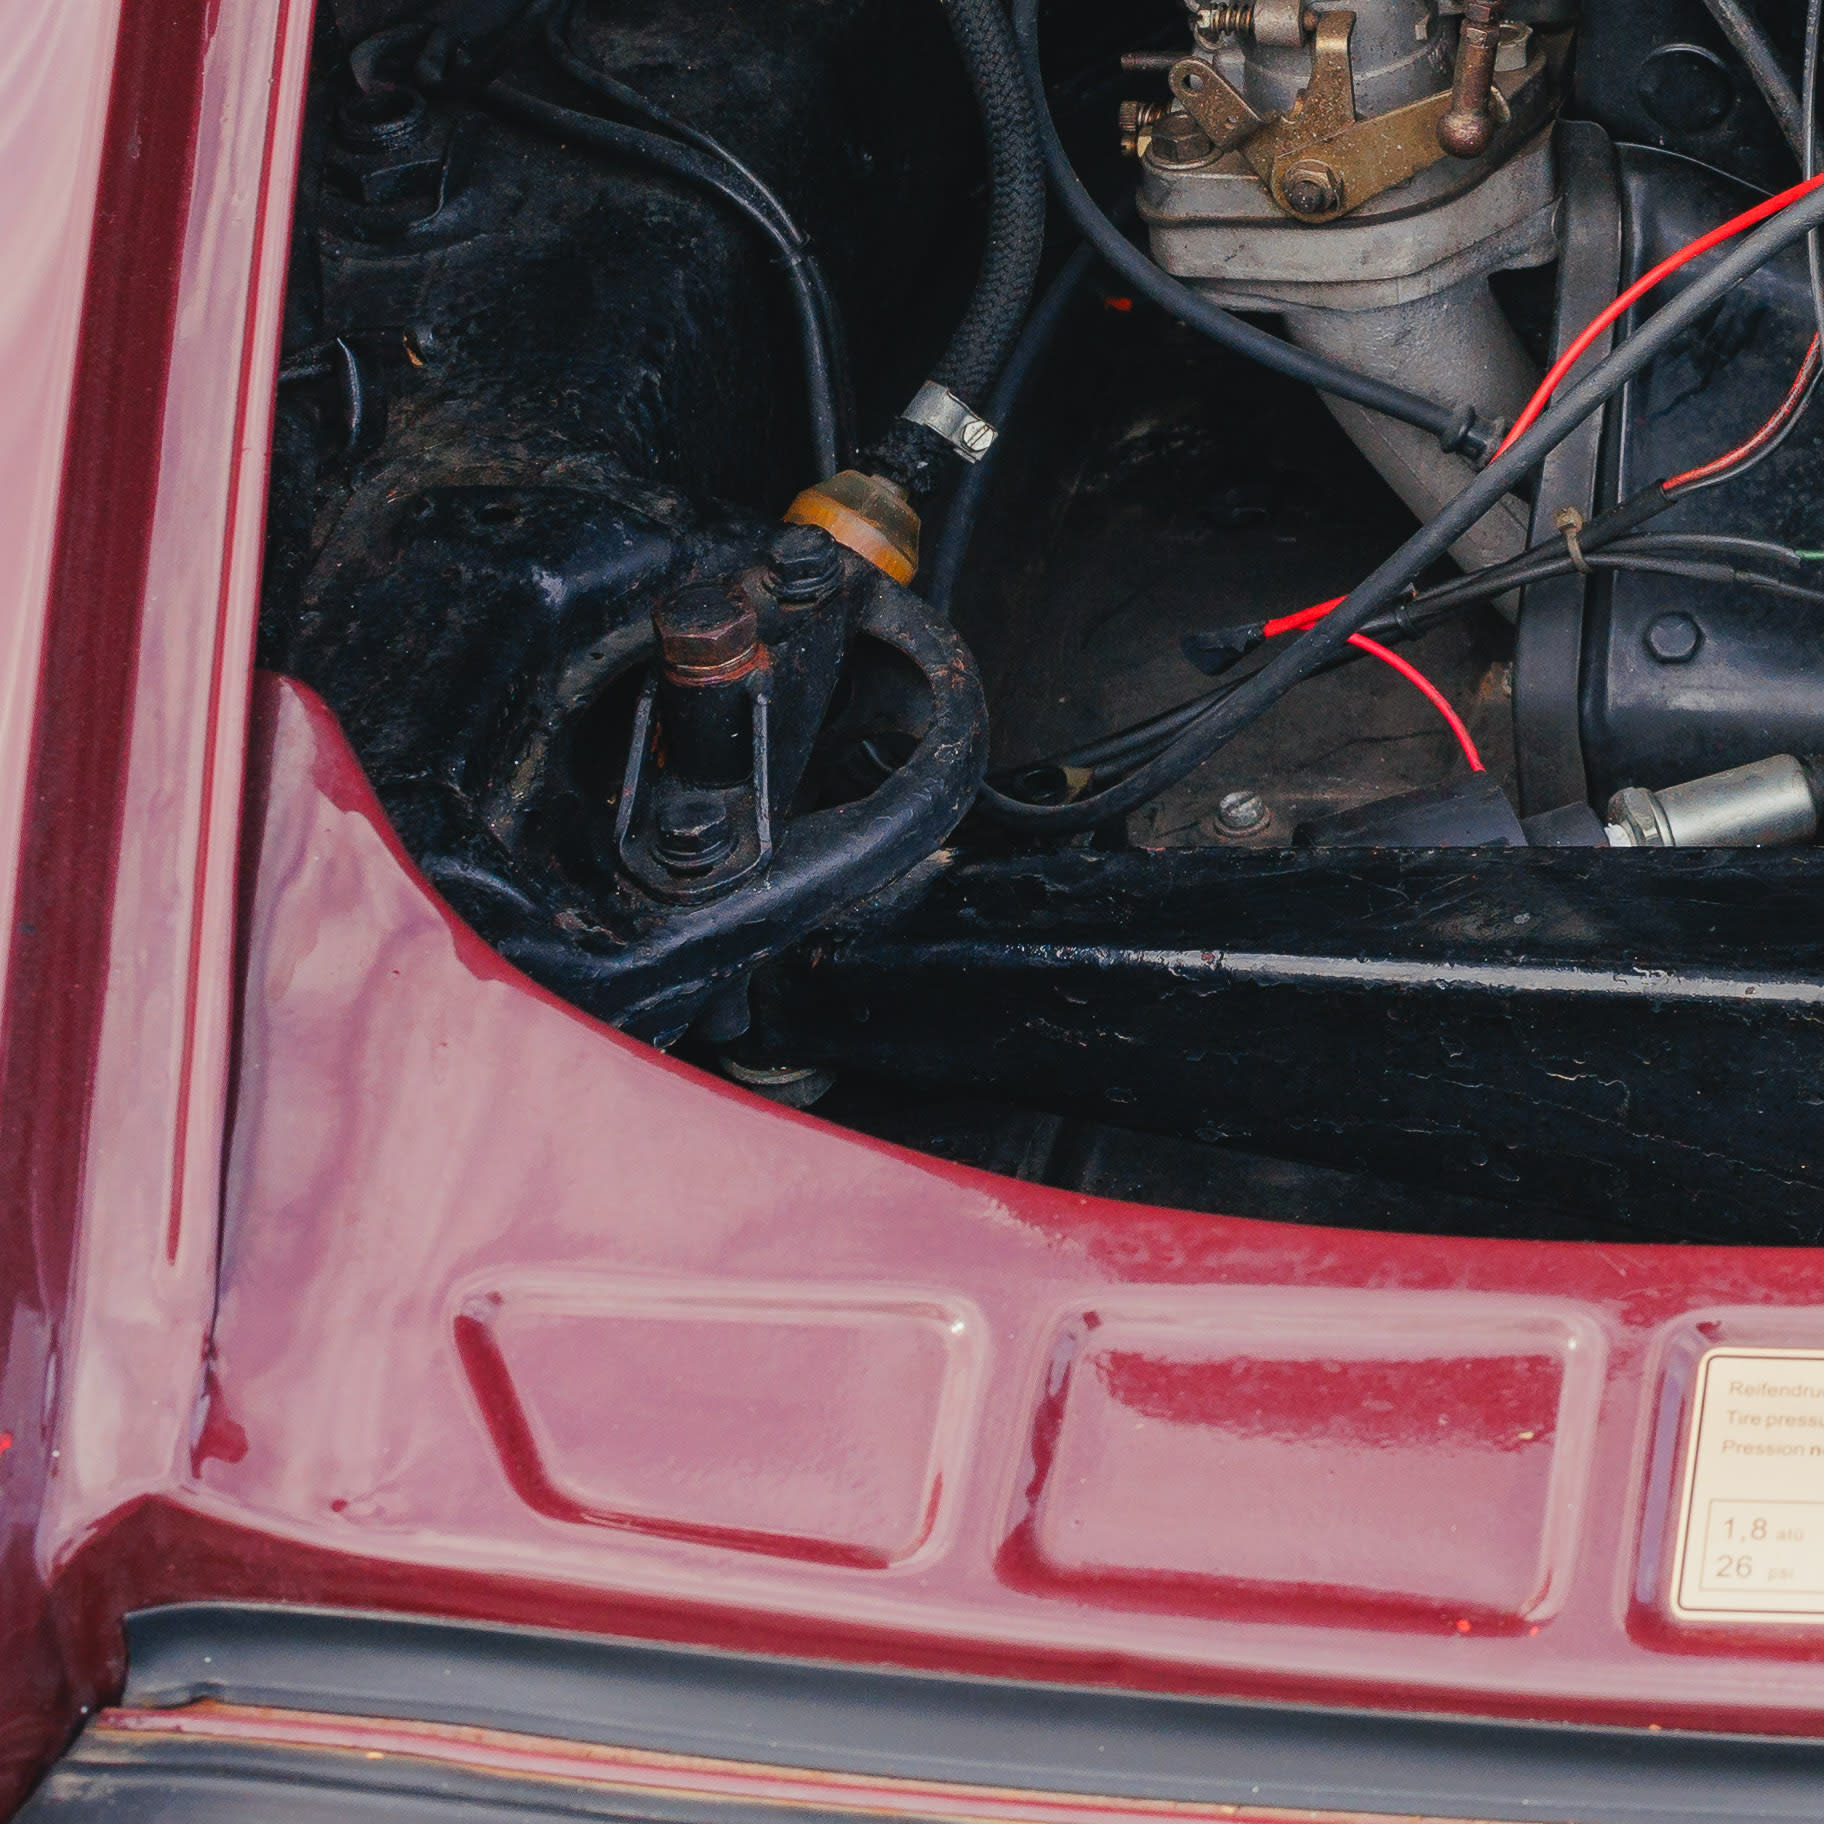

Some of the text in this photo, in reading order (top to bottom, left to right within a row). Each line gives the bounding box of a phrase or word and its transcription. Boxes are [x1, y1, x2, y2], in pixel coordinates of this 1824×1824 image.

[1727, 1409, 1761, 1426] Tire
[1722, 1439, 1804, 1457] Pression
[1724, 1517, 1767, 1543] 1,8
[1716, 1553, 1752, 1579] 26
